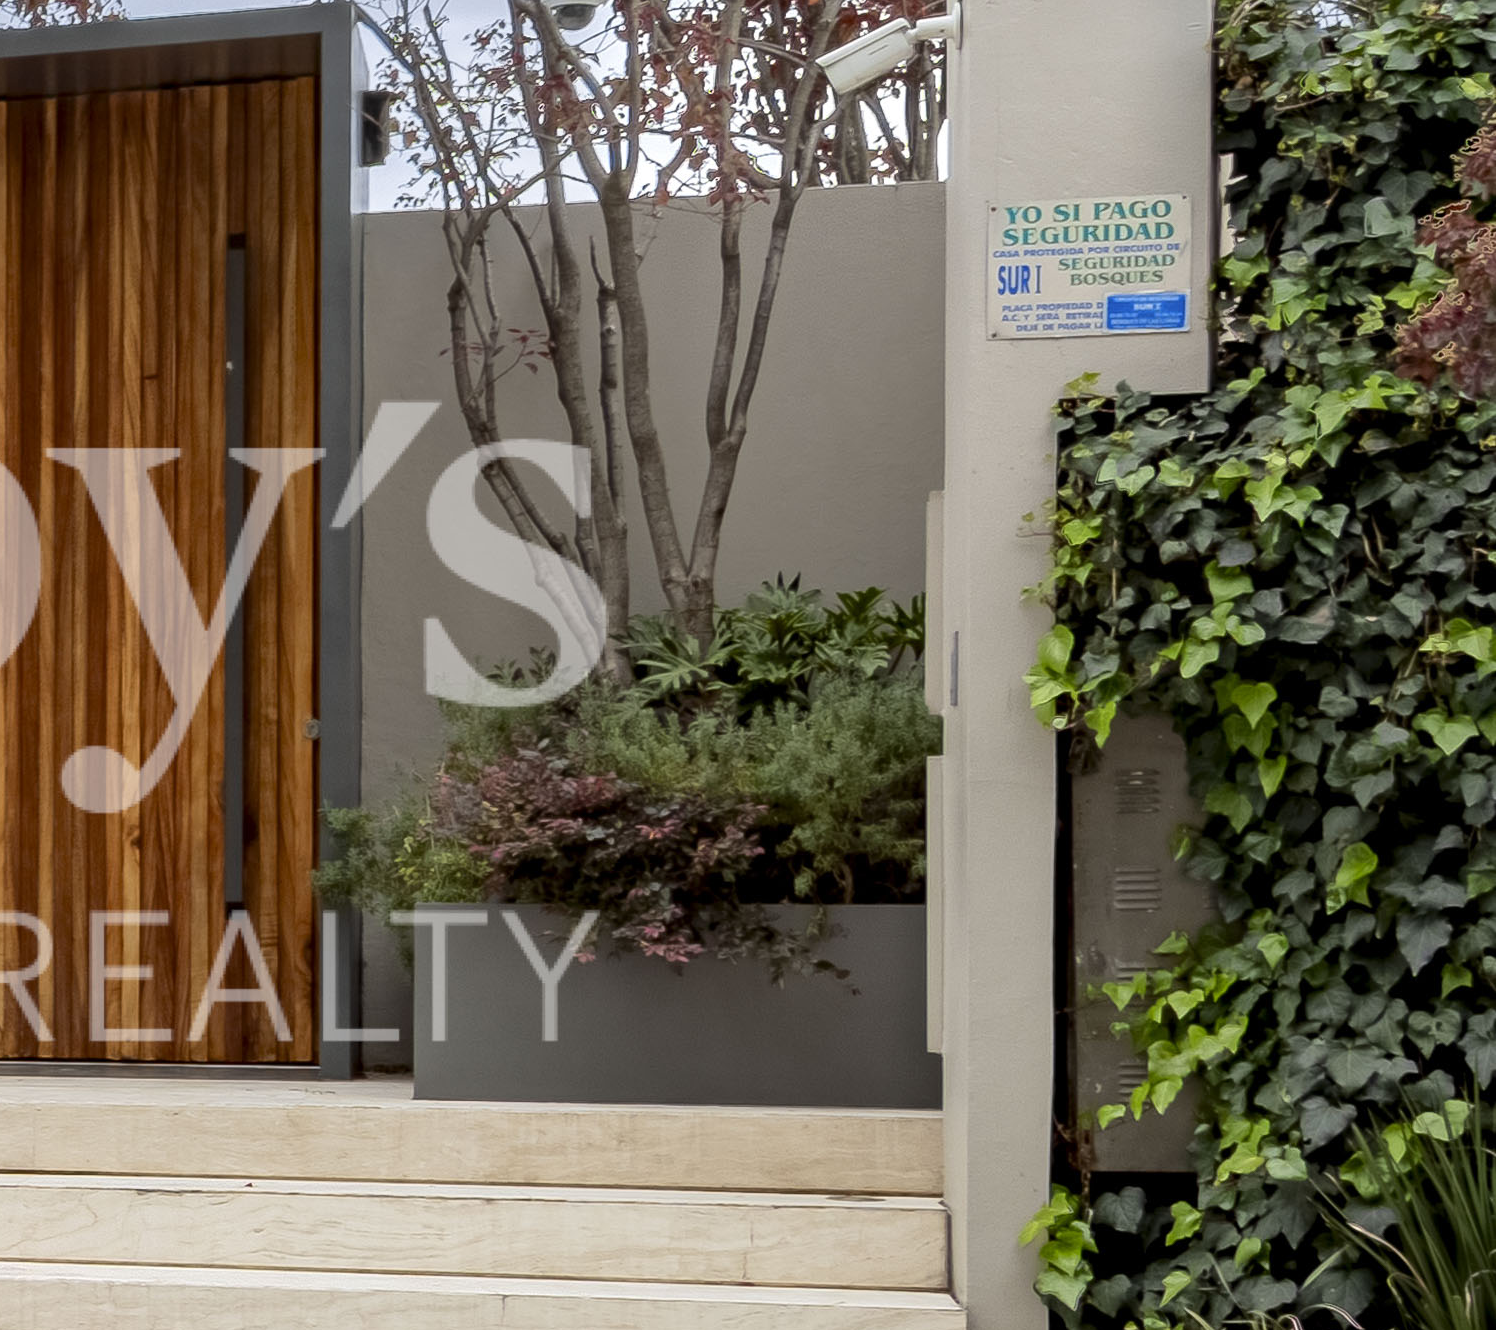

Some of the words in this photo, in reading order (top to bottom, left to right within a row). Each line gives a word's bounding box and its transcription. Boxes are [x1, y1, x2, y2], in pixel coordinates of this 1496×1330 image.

[1004, 206, 1042, 224] YO
[1053, 203, 1080, 222] SI
[1093, 200, 1172, 220] PAGO
[1002, 222, 1175, 246] SEGURIDAD
[993, 250, 1020, 259] CASA
[1023, 248, 1084, 257] PROTEGIDA
[1088, 246, 1110, 254] POR
[1114, 244, 1163, 254] CIRCUITO
[1167, 243, 1180, 251] DE
[1058, 254, 1176, 271] SEGURIDAD
[998, 265, 1031, 295] SUR
[1035, 265, 1042, 294] I
[1070, 270, 1164, 286] BOSQUES
[1002, 304, 1033, 313] PLACA
[1036, 302, 1094, 311] PROPIEDAD
[1036, 312, 1060, 321] SERA
[1016, 324, 1038, 332] DEJE
[1042, 323, 1054, 331] DE
[1057, 322, 1091, 331] PAGAR
